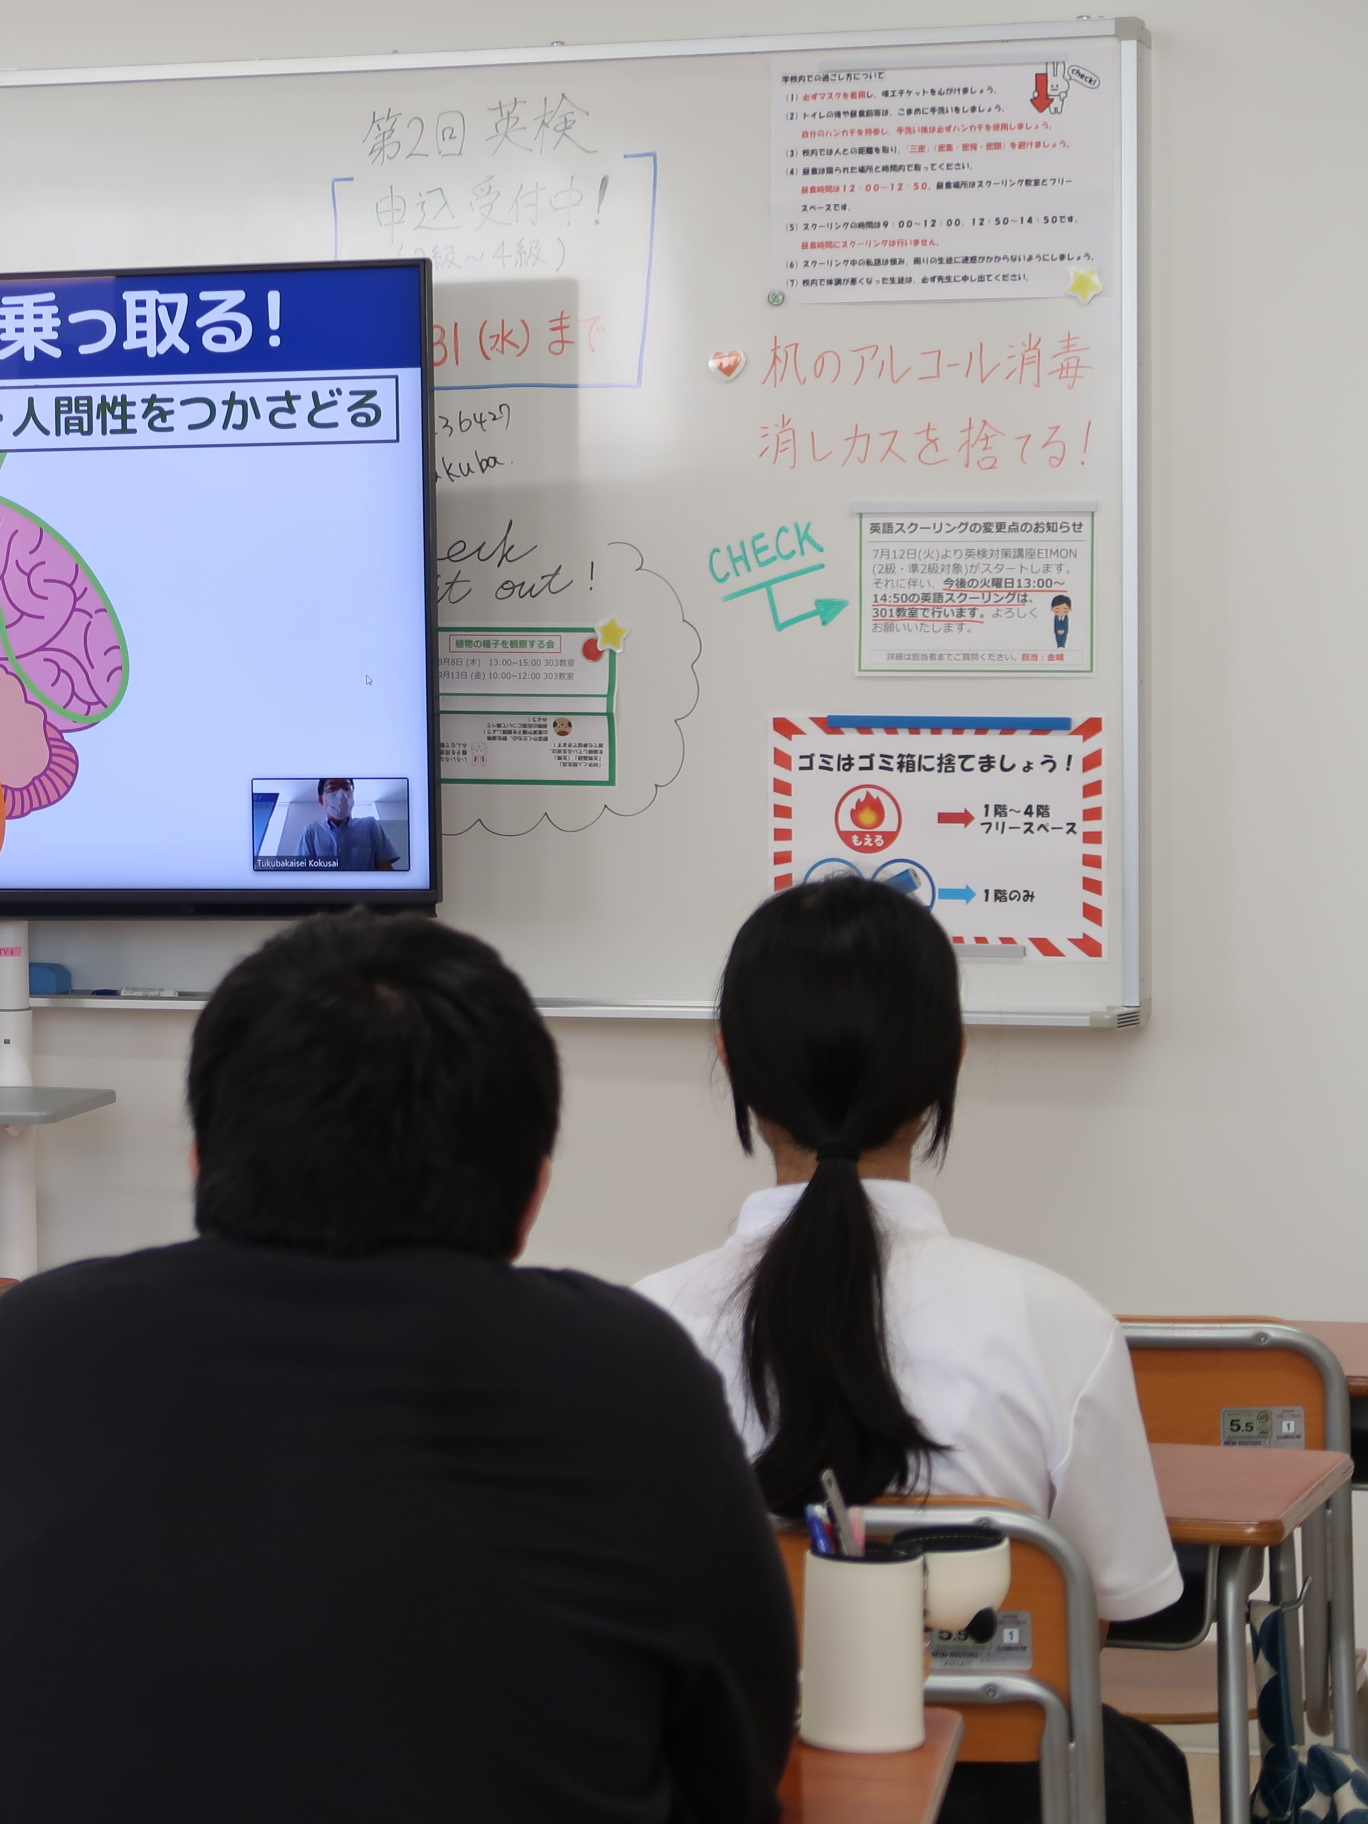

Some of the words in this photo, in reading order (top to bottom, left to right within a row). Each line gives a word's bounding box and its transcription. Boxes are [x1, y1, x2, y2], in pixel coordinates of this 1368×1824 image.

[1071, 68, 1097, 86] check!
[362, 107, 465, 166] 第2回
[485, 92, 598, 156] 英検
[761, 330, 1093, 389] 机のアルコール消毒
[758, 413, 1092, 471] 消しカスを捨てる!
[869, 521, 1084, 535] 英語スクーリングの変更点のお知らせ
[708, 521, 825, 585] CHECK
[872, 548, 1078, 561] 7月12日(火)より英検対策講座EIMON
[872, 563, 1072, 576] (2級・準2級対象)がスタートします。
[872, 577, 1065, 590] それに伴い、今後の火曜日13:00～
[872, 592, 1034, 604] 14:50の英語スクーリングは、
[872, 607, 1039, 619] 301教室で行います。よろしく
[872, 622, 972, 634] お願いいたします。
[798, 753, 1074, 774] ゴミはゴミ箱に捨てましょう!
[983, 804, 1051, 818] 1階～4階
[980, 822, 1078, 835] フリースペース
[851, 834, 885, 847] もえる
[257, 859, 307, 868] Tukubakaisei
[309, 859, 339, 868] Kokusai
[983, 889, 1036, 903] 1階のみ
[1229, 1419, 1254, 1433] 5.5
